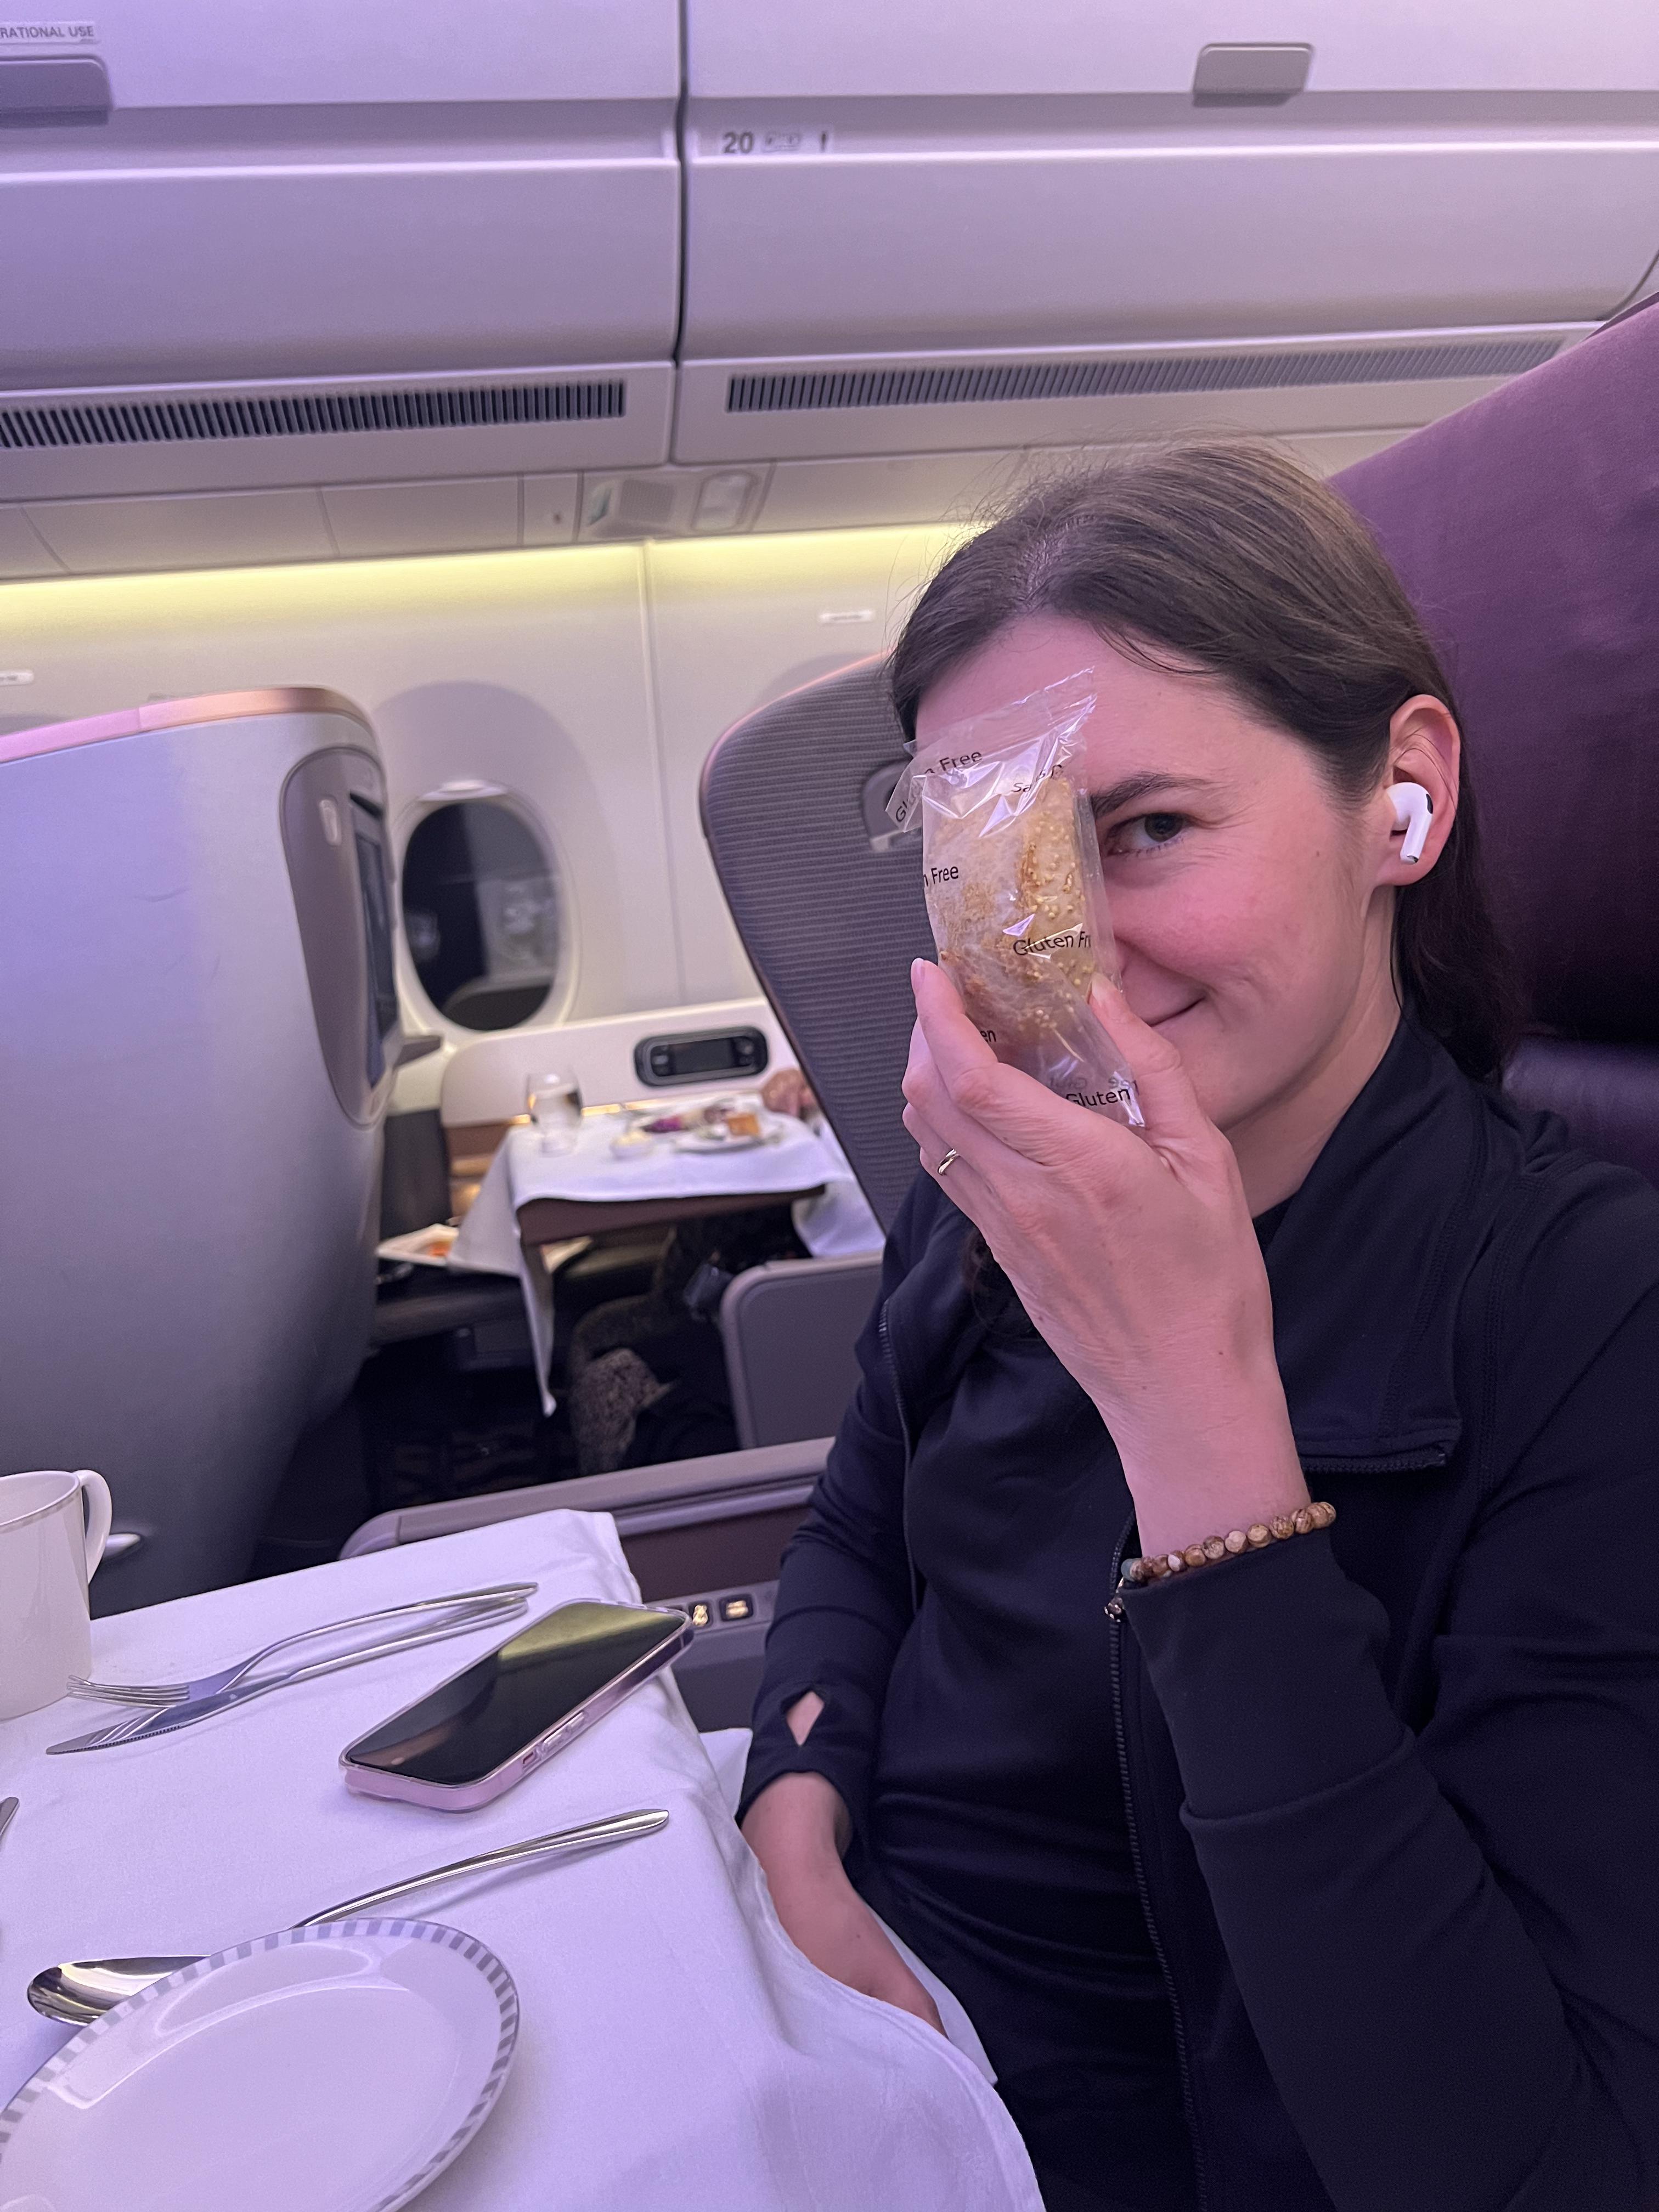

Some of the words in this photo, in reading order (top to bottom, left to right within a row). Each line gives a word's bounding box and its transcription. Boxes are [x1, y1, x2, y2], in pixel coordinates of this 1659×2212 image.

[0, 26, 65, 38] RATIONAL
[68, 26, 94, 37] USE
[722, 131, 754, 154] 20
[939, 750, 983, 771] Free
[931, 866, 959, 885] Free
[1013, 935, 1074, 956] Gluten
[1066, 1088, 1131, 1107] Gluten
